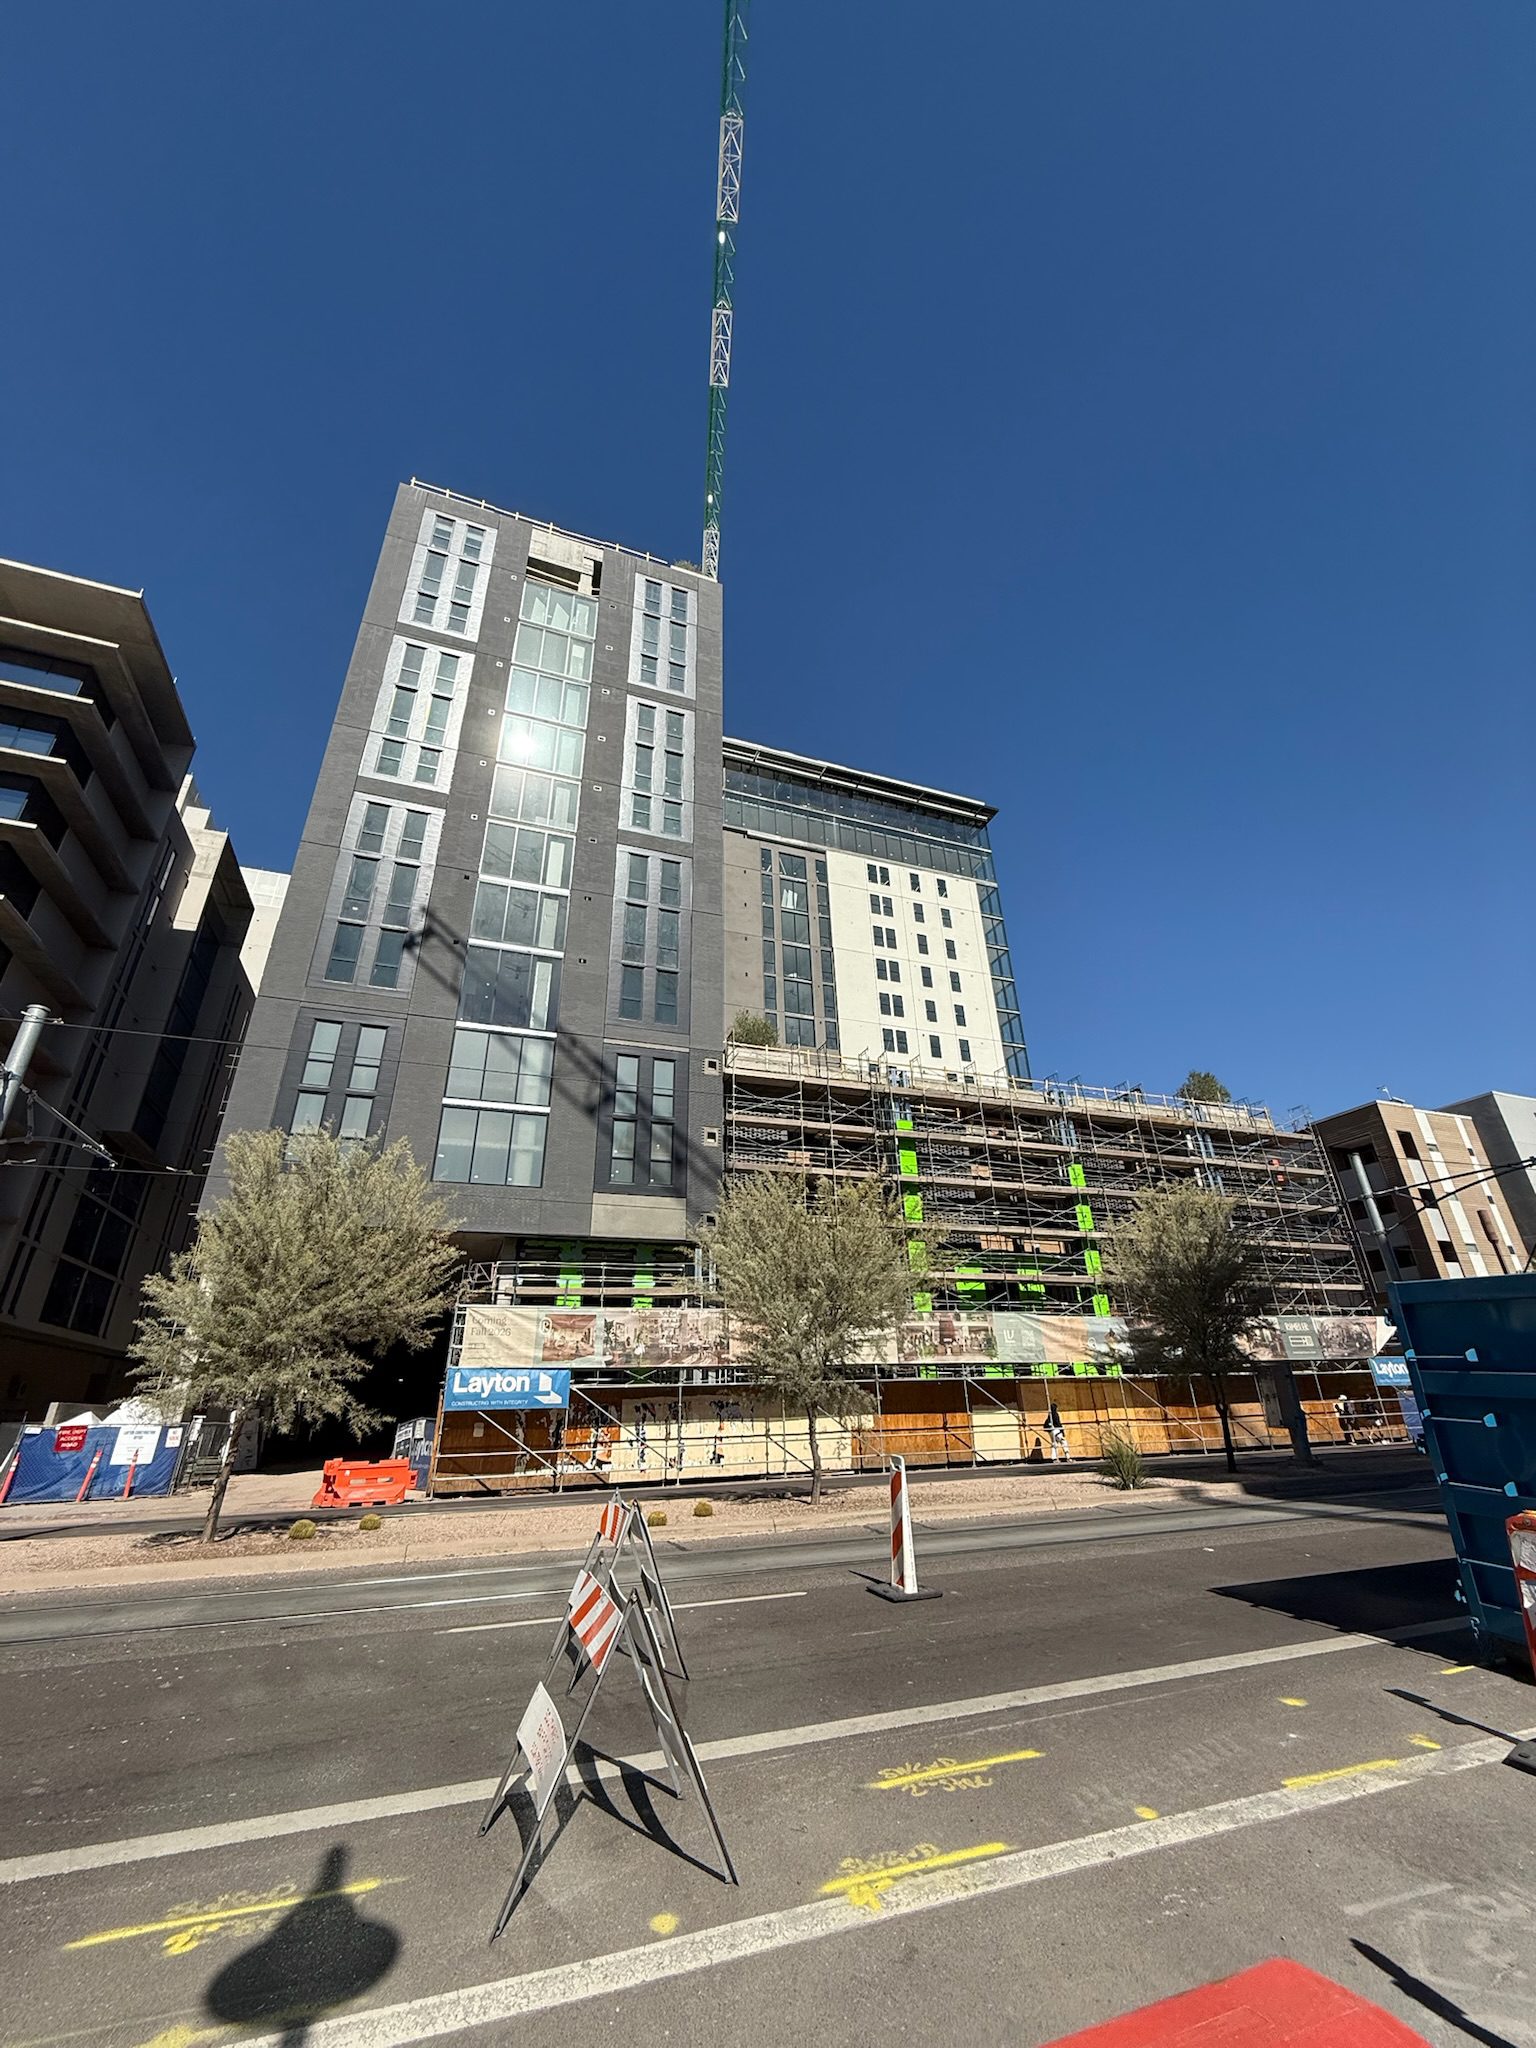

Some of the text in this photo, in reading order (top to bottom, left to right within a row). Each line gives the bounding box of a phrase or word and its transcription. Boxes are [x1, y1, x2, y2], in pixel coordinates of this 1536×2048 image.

[472, 1316, 507, 1326] Coming
[471, 1327, 487, 1336] Fall
[1373, 1361, 1409, 1378] Layton
[453, 1371, 530, 1398] Layton
